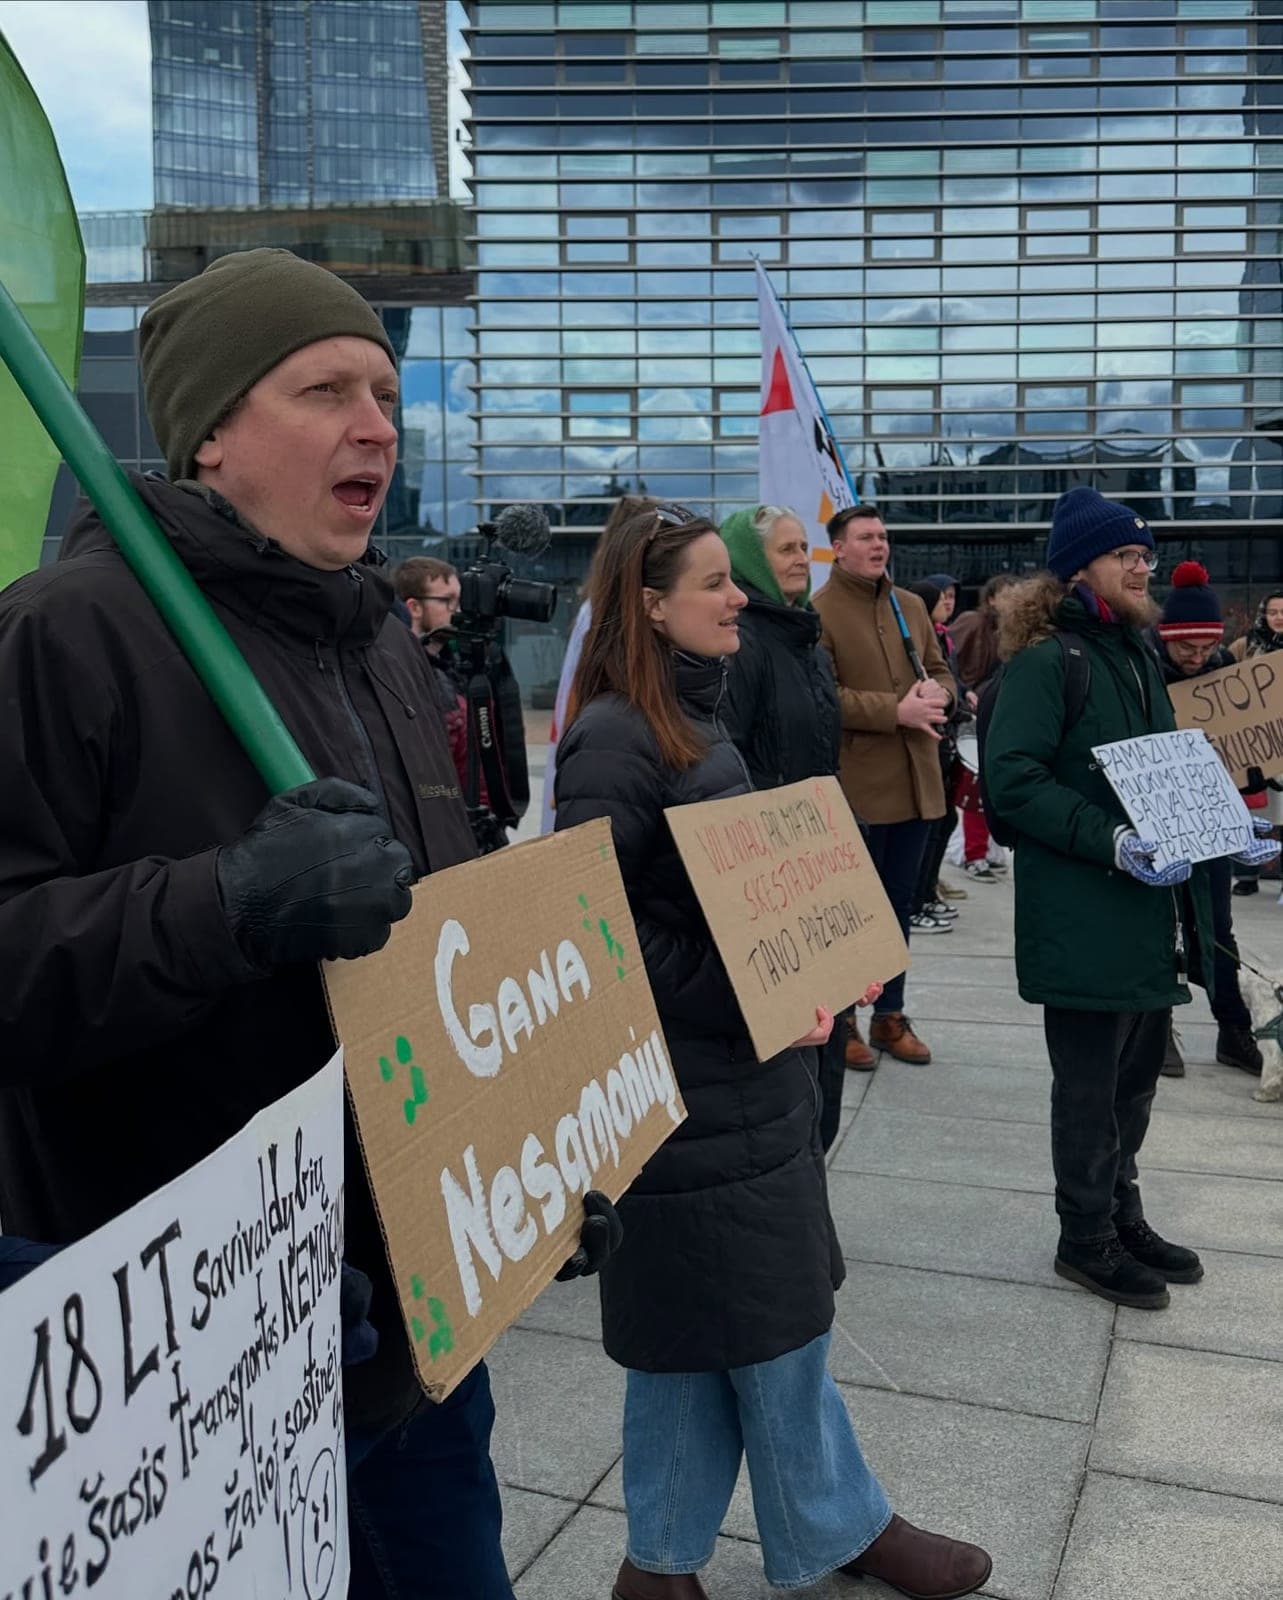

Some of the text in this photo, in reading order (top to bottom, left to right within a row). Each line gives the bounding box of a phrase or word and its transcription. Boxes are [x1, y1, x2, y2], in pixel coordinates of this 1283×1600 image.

[1192, 663, 1275, 722] STOP
[479, 706, 492, 748] Canon
[747, 928, 800, 994] TAVO
[17, 1292, 102, 1491] 18
[113, 1218, 182, 1406] LT
